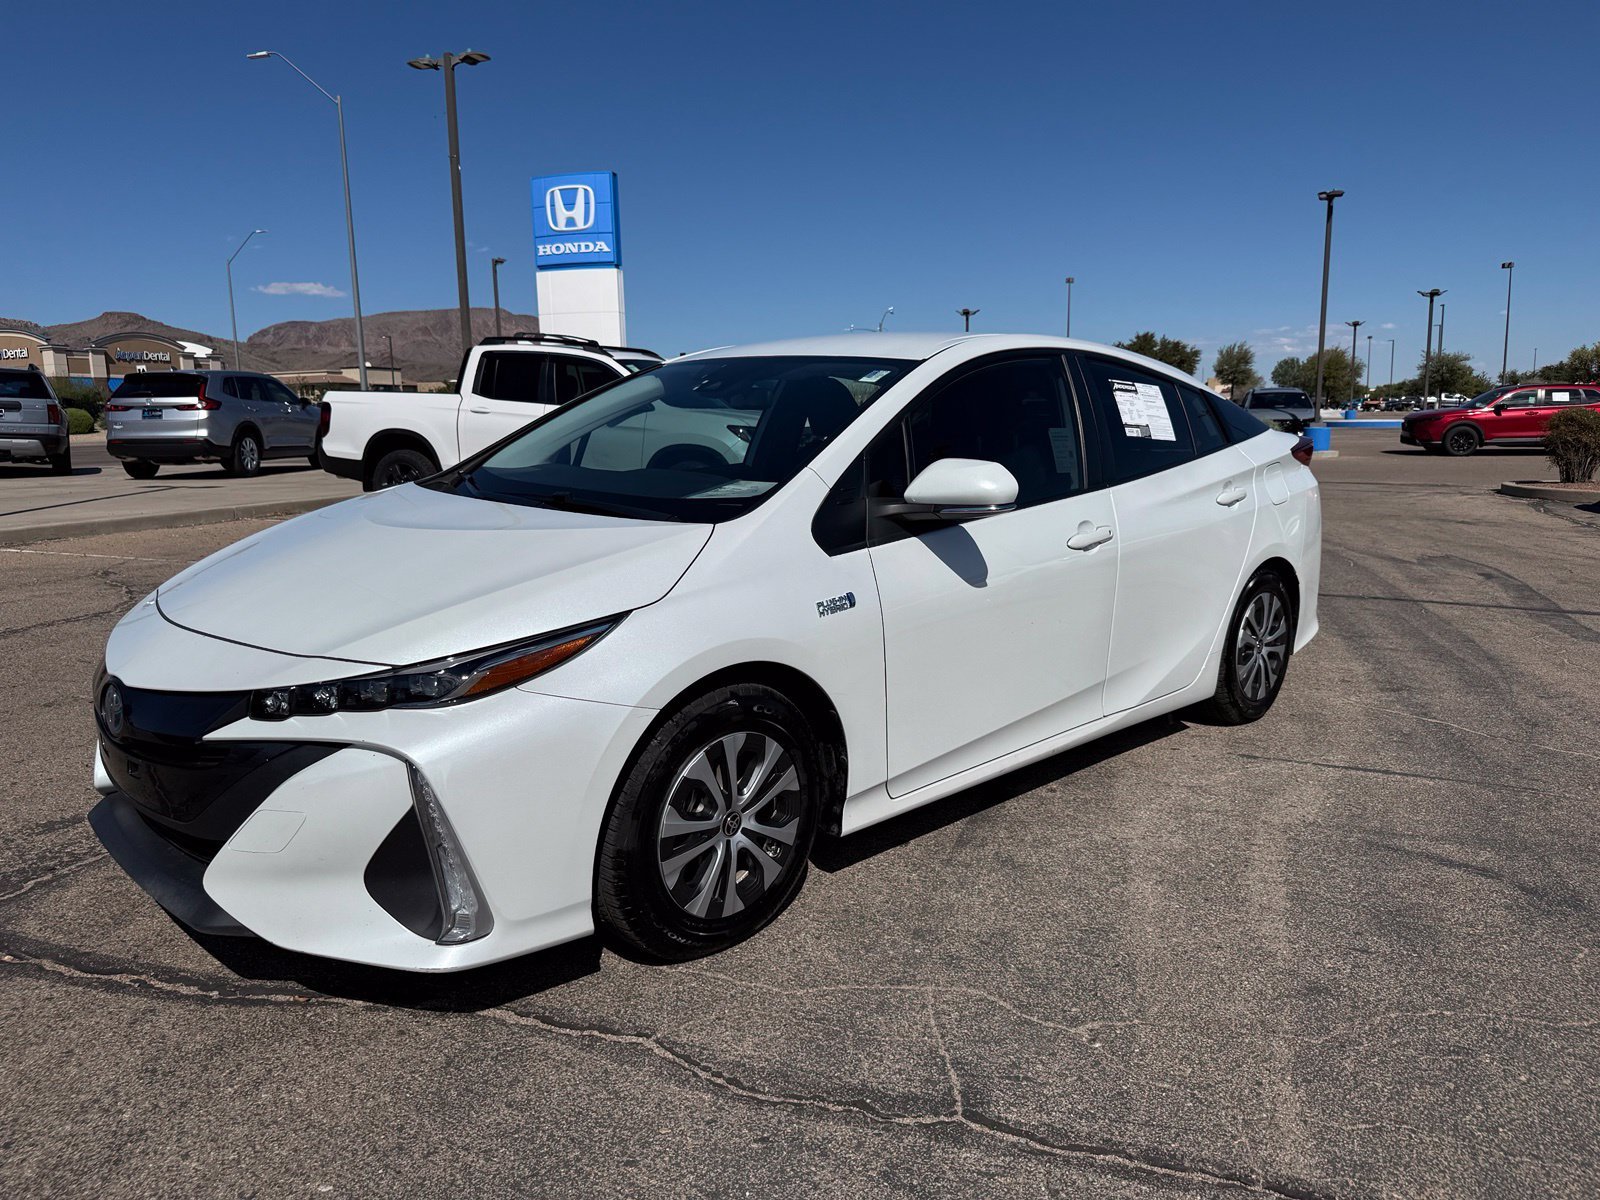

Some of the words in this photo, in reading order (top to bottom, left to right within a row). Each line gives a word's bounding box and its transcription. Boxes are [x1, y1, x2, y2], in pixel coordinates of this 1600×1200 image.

[537, 241, 611, 256] HONDA
[2, 347, 28, 359] Dental
[143, 350, 170, 361] Dental
[816, 594, 848, 609] PLUG-IN
[817, 602, 849, 618] HYBRID
